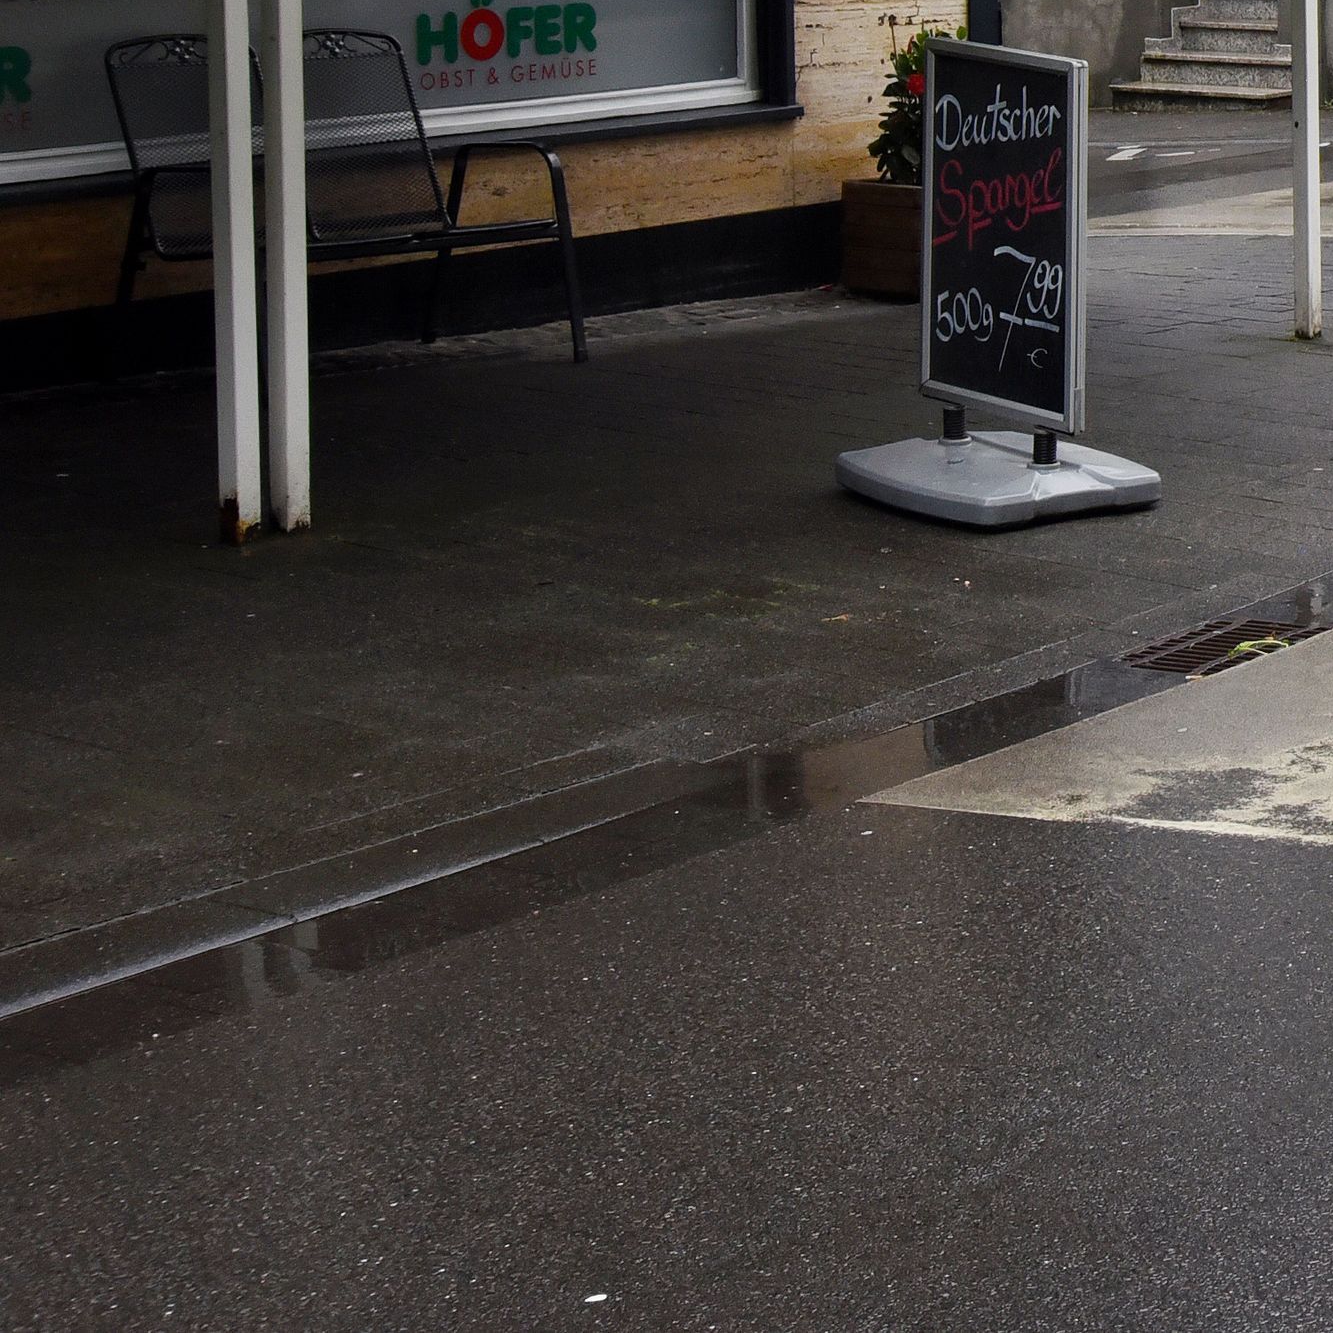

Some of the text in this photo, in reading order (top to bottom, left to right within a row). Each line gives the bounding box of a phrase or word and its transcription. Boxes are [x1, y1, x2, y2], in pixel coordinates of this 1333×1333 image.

[420, 58, 598, 91] OBST & GEMÜSE
[935, 83, 1062, 152] Deutscher
[935, 146, 1065, 251] Spargel
[935, 286, 994, 344] 500g
